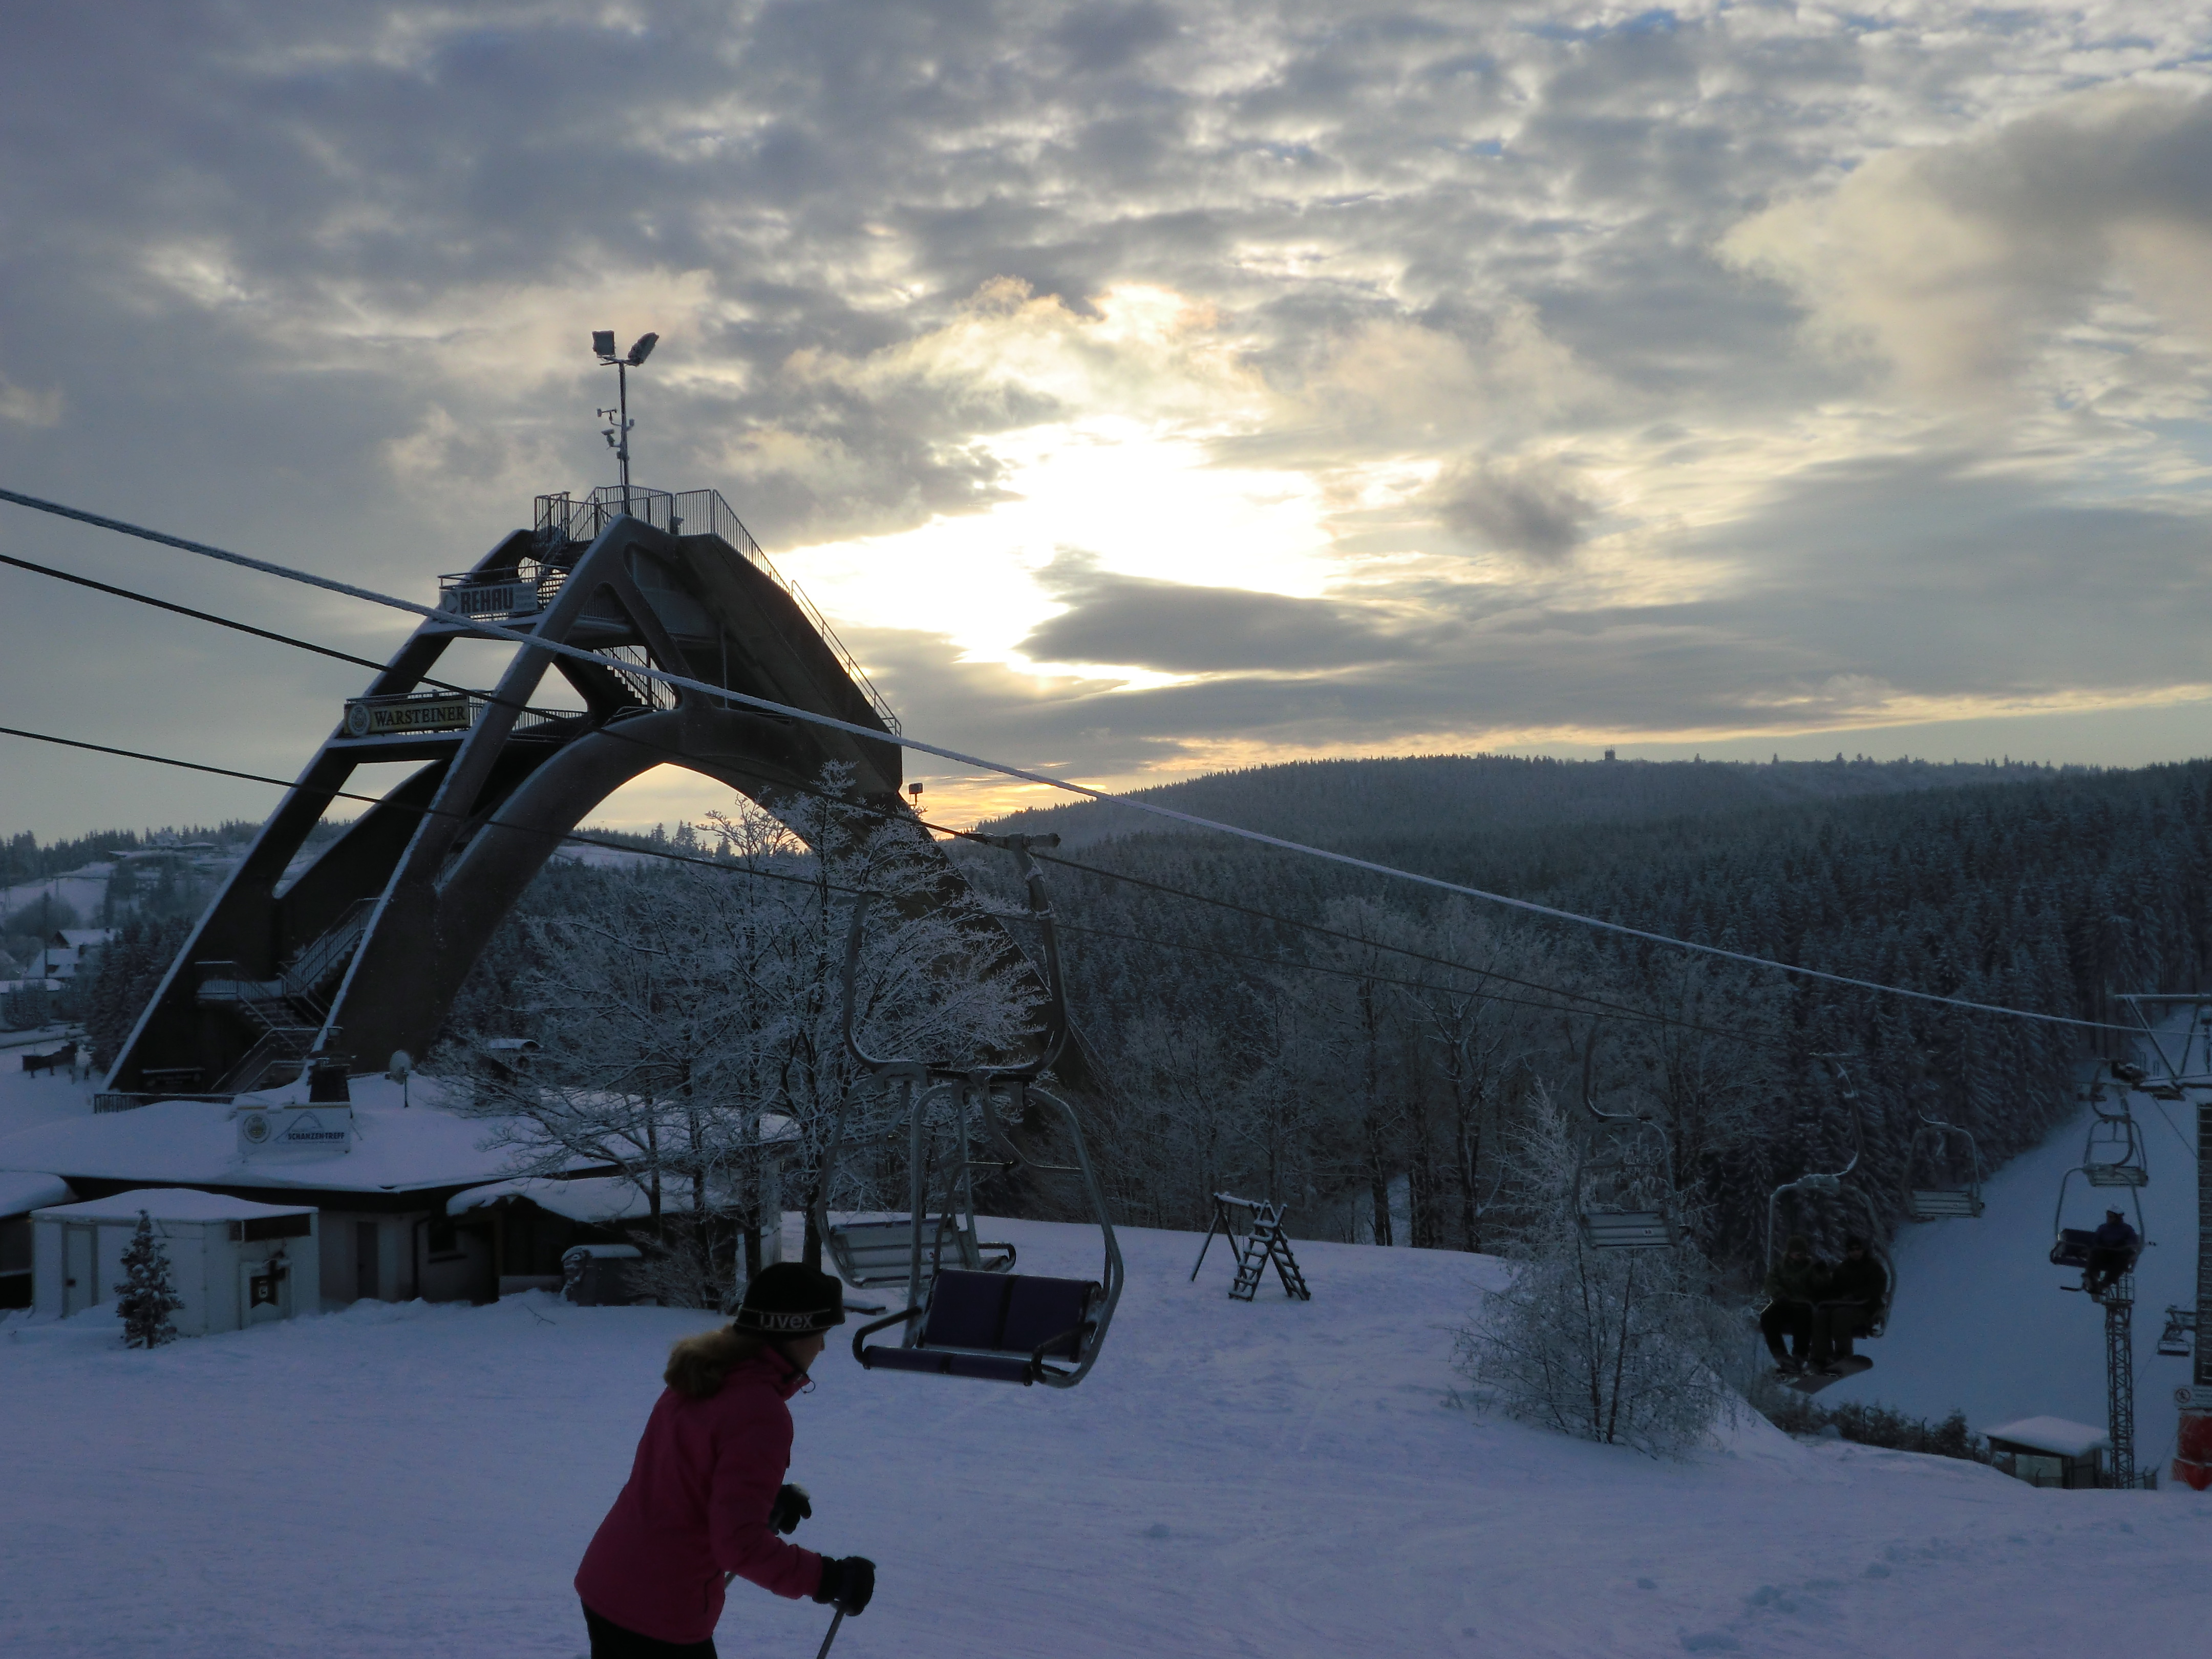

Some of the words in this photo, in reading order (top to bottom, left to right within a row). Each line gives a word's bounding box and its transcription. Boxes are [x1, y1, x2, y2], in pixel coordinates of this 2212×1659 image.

[461, 588, 513, 612] REHAU
[374, 706, 465, 727] WARSTEINER
[759, 1312, 814, 1330] uvex
